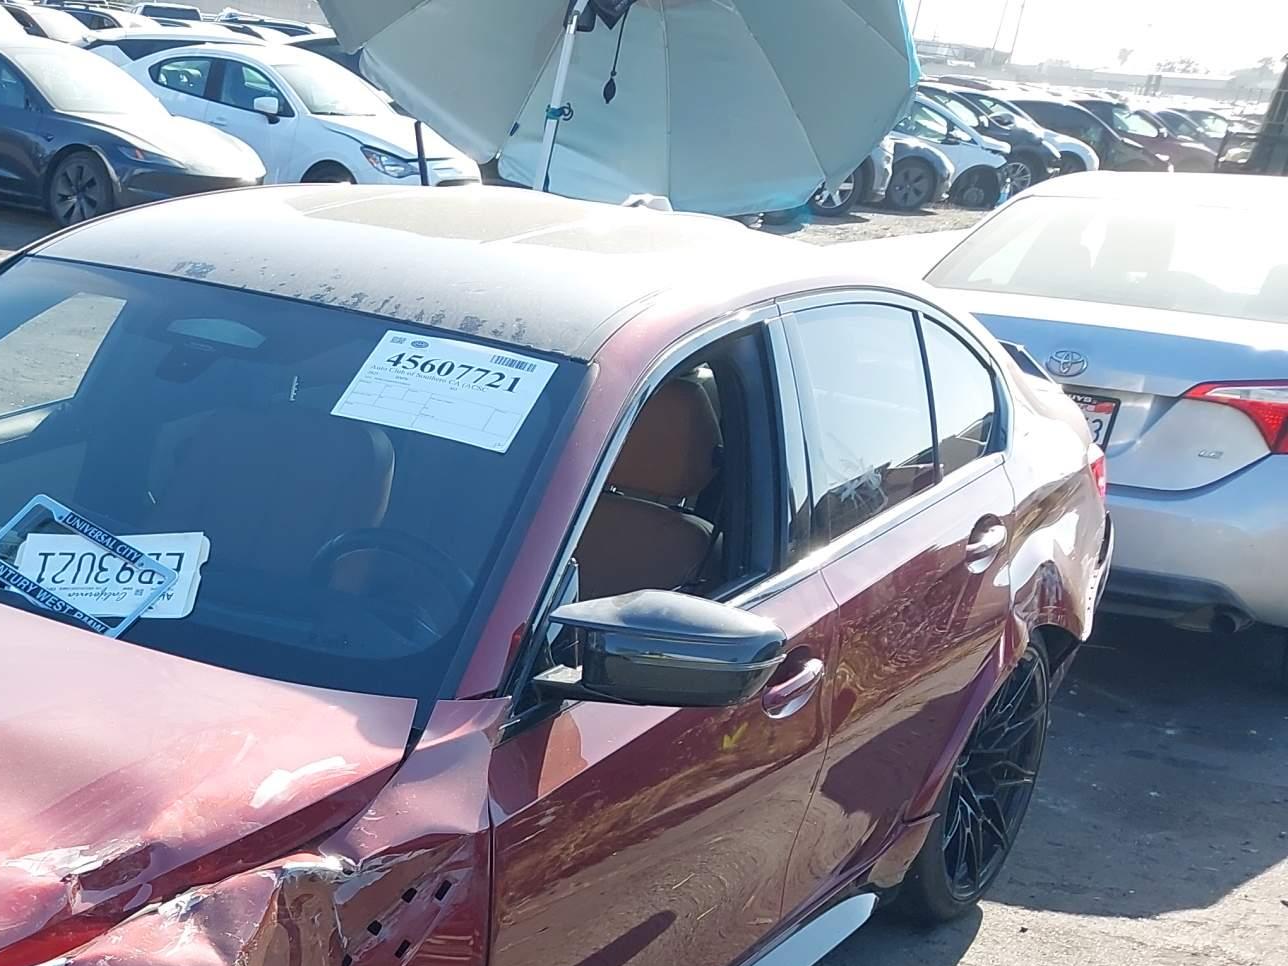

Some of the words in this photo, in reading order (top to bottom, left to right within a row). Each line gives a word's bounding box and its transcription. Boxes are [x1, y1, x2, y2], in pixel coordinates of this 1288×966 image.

[385, 352, 520, 394] 45607721
[66, 514, 114, 550] UNIVERSAL
[115, 544, 142, 562] CITY
[35, 589, 74, 614] WEST
[68, 587, 128, 602] California
